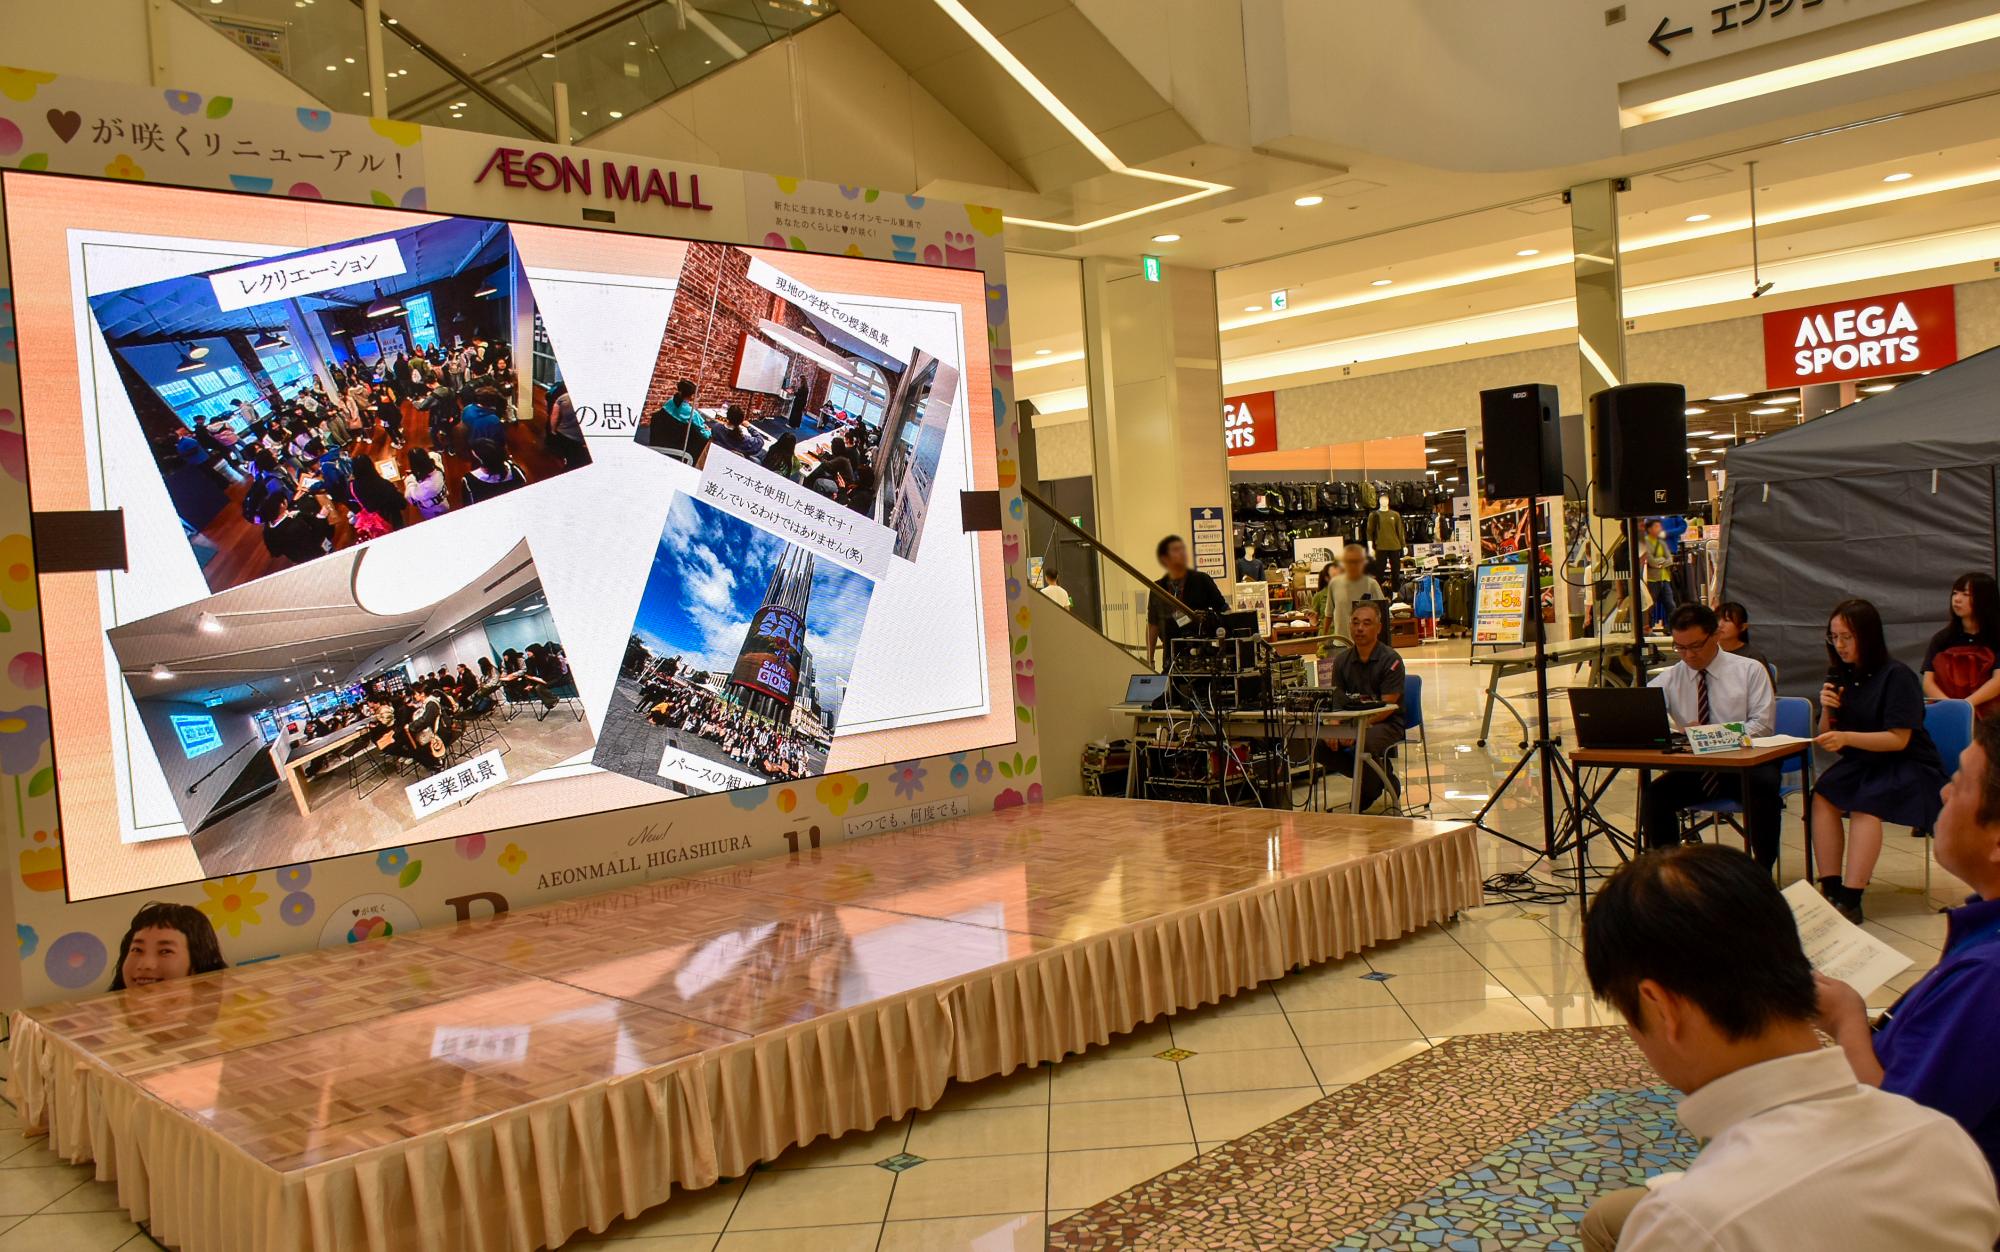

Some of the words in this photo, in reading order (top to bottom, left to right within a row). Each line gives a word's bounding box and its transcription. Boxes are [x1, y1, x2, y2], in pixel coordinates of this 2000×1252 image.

[603, 161, 713, 211] MALL
[238, 254, 378, 295] レクリエーション
[776, 277, 889, 347] 現地の学校での授業風景
[1794, 301, 1918, 347] MEGA
[1794, 335, 1920, 375] SPORTS
[1223, 402, 1255, 428] GA
[1225, 426, 1256, 449] RTS
[722, 466, 853, 535] スマホを使用した授業です！
[704, 480, 863, 565] 遊んでいるわけではありません(笑)
[763, 660, 786, 677] SAVE
[417, 759, 497, 808] 授業風景
[667, 757, 752, 790] パースの観
[627, 822, 673, 847] New!
[537, 856, 641, 890] AEONMALL
[647, 834, 752, 868] HIGASHIURA
